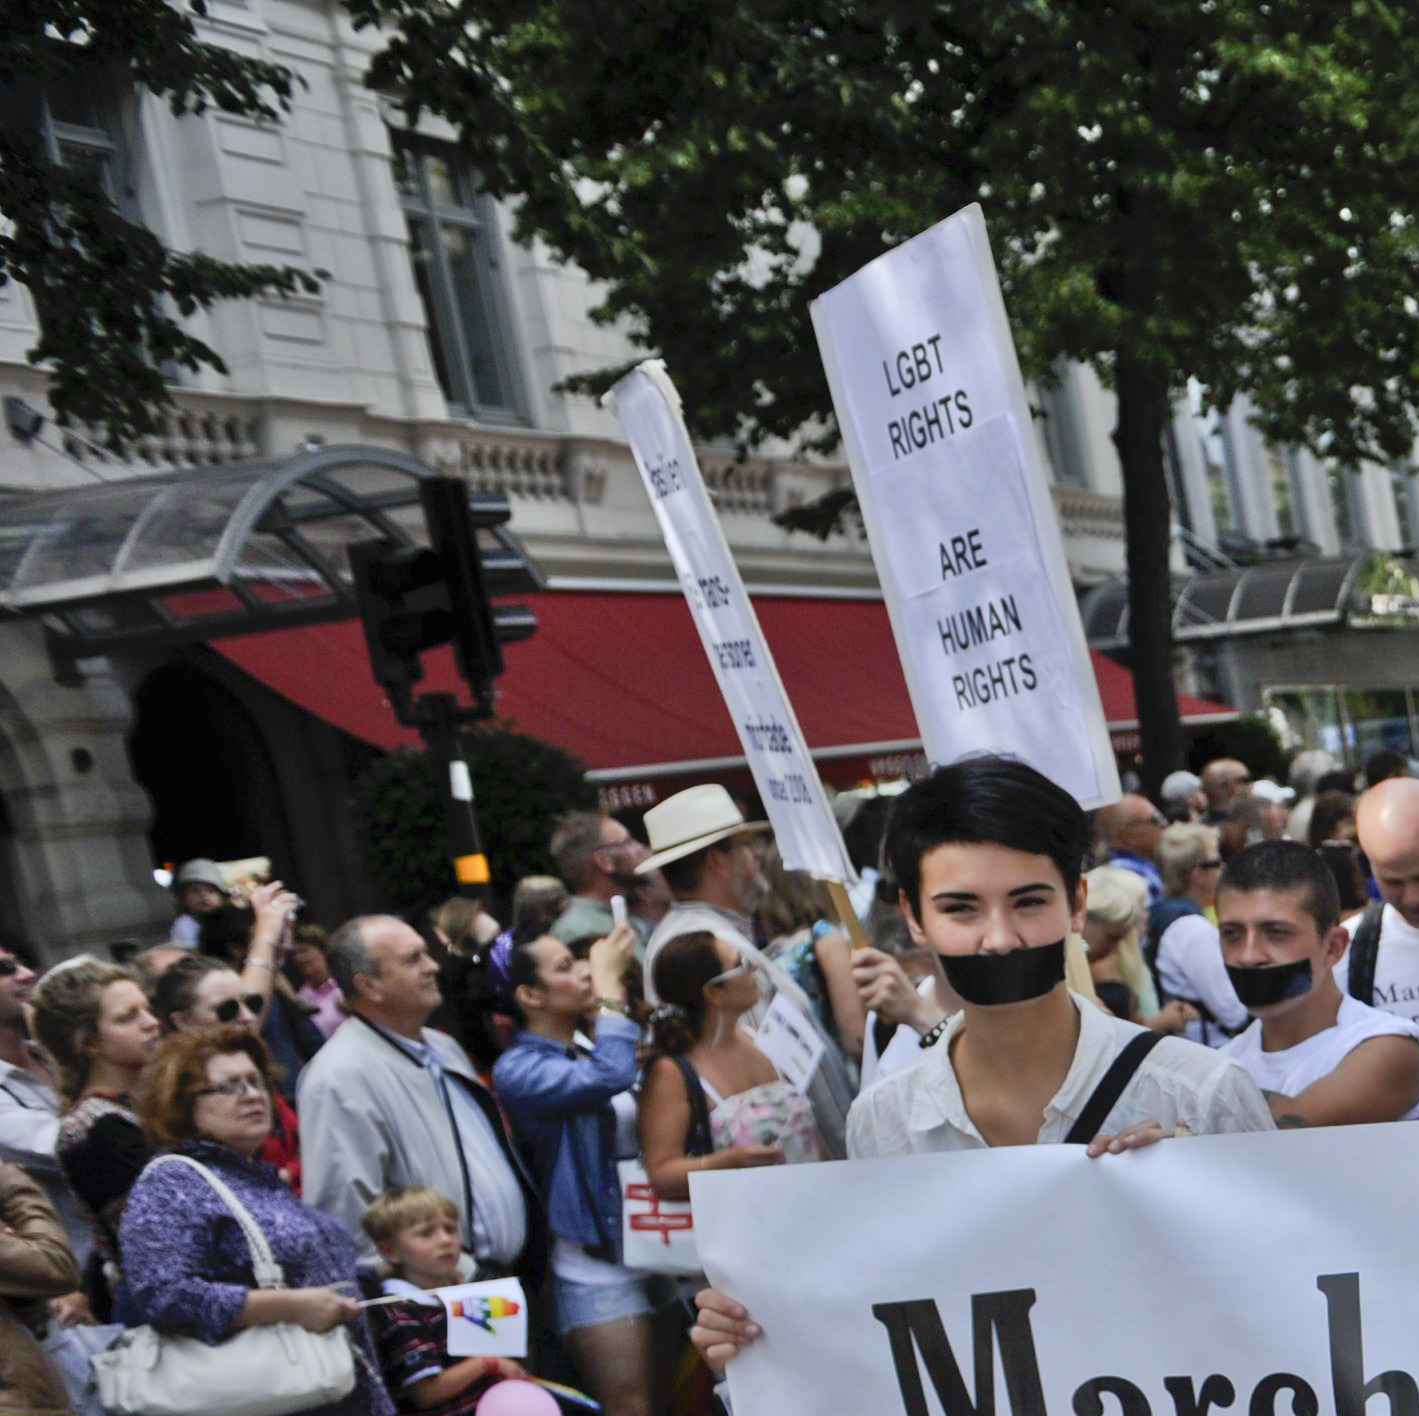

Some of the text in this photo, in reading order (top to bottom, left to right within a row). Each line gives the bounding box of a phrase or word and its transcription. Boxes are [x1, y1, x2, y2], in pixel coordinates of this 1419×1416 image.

[883, 333, 944, 397] LGBT
[888, 390, 973, 459] RIGHTS
[939, 529, 987, 581] ARE
[938, 595, 1022, 655] HUMAN
[952, 653, 1037, 710] RIGHTS
